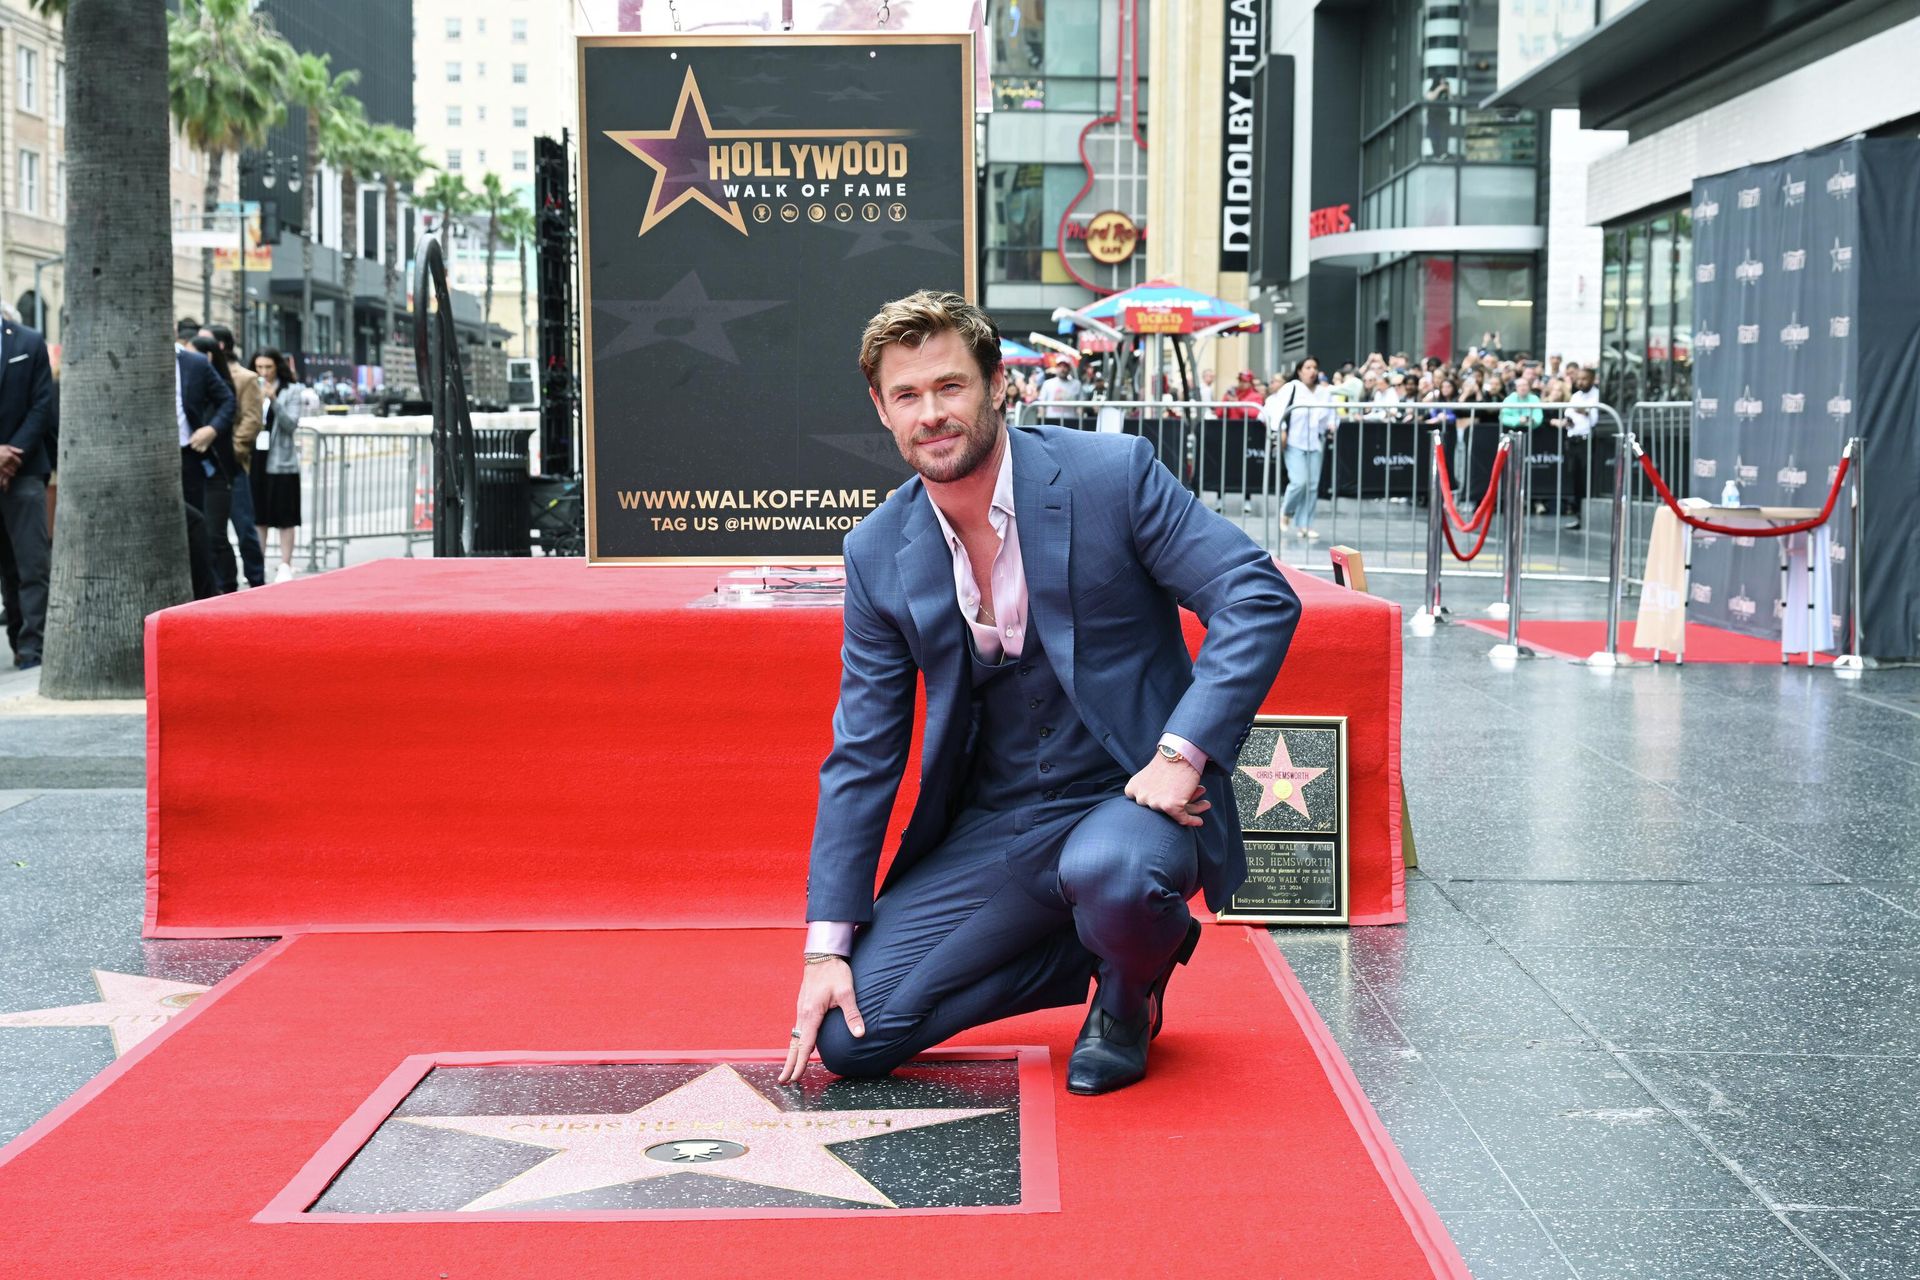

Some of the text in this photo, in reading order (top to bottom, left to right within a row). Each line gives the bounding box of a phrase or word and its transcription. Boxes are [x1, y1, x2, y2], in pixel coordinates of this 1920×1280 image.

[1227, 91, 1253, 201] DOLBY
[709, 141, 908, 180] HOLLYWOOD
[723, 183, 907, 198] WALK OF FAME
[651, 516, 867, 532] TAG US @HWDWALKOF
[1256, 771, 1310, 780] CHRIS HEMSWORTH
[1244, 843, 1276, 851] LLYWOOD
[1279, 843, 1297, 851] WALK
[1246, 856, 1331, 867] RIS HEMSWORTH
[1279, 876, 1298, 884] WALK
[1313, 876, 1331, 884] FAME
